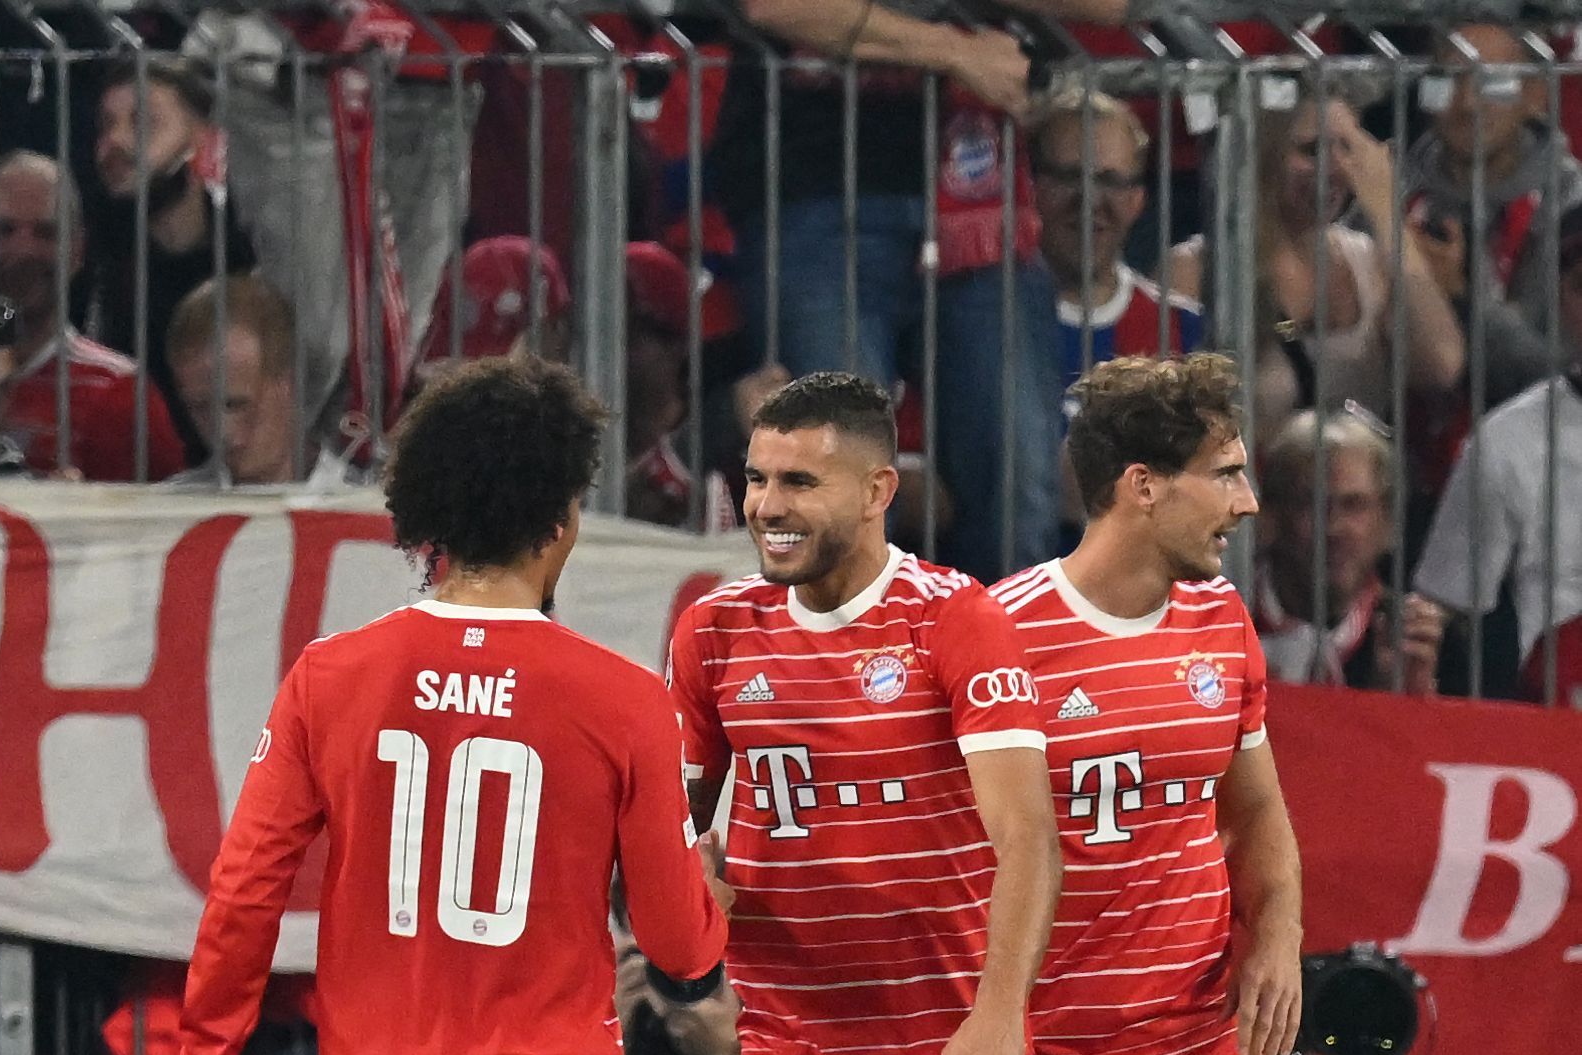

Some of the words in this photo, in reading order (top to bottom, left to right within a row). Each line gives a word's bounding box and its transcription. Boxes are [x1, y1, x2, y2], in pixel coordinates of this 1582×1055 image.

[414, 667, 516, 718] SANÉ
[377, 729, 544, 947] 10
[1384, 762, 1582, 957] B
